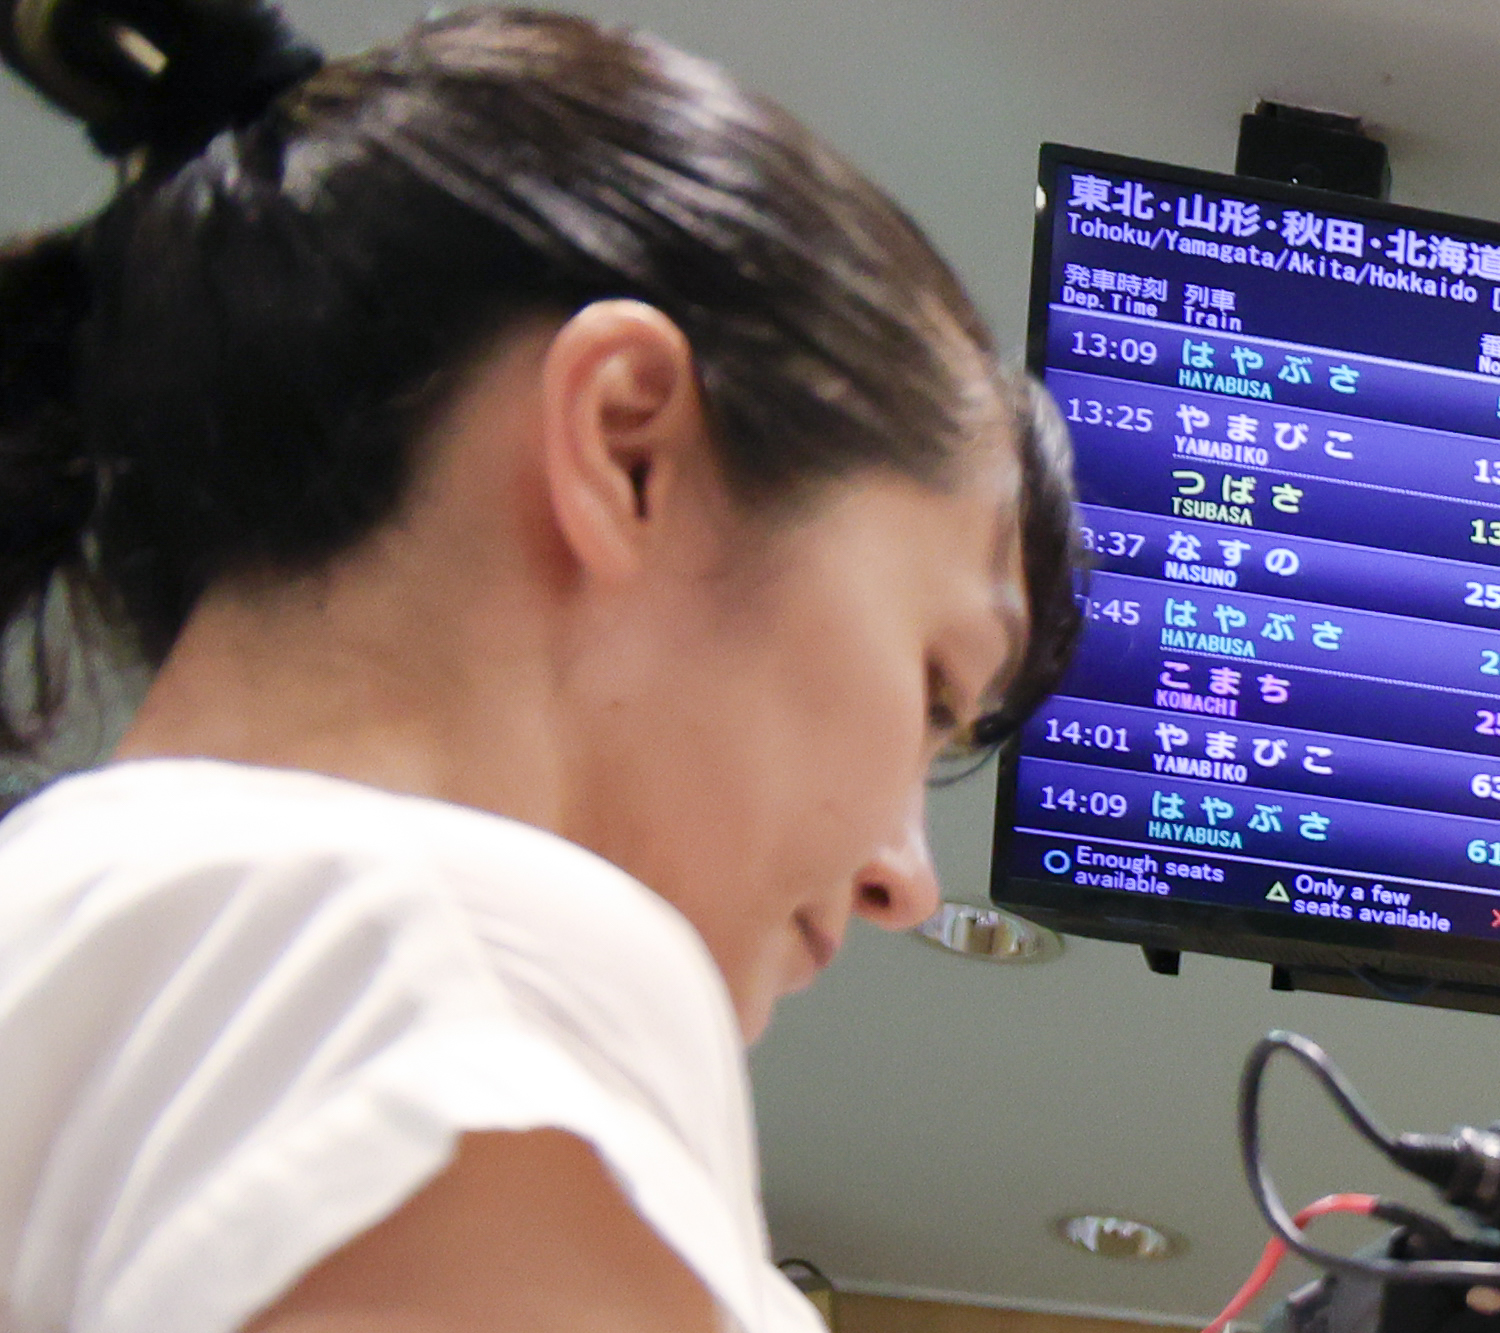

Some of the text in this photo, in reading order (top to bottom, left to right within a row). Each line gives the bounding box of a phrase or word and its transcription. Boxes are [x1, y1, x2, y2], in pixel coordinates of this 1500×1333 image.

[1067, 212, 1478, 303] Tohoku/Yamagata/Akita/Hokkaido
[1064, 263, 1237, 312] 発車時刻 列車
[1183, 305, 1242, 332] Train
[1070, 330, 1159, 366] 13:09
[1180, 336, 1361, 395] はやぶさ
[1178, 368, 1273, 400] HAYABUSA
[1067, 398, 1154, 433] 13:25
[1175, 401, 1354, 461] やまびこ
[1173, 436, 1269, 467] YAMABIKO
[1171, 468, 1304, 513] つばさ
[1171, 497, 1253, 526] TSUBASA
[1079, 527, 1146, 558] 3:37
[1167, 530, 1300, 577] なすの
[1163, 560, 1238, 588] NASUNO
[1160, 627, 1256, 658] HAYABUSA
[1163, 598, 1343, 651] はやぶさ
[1158, 660, 1292, 705] こまち
[1156, 688, 1239, 719] KOMACHI
[1045, 717, 1130, 753] 14:01
[1154, 722, 1334, 778] やまびこ
[1152, 753, 1248, 784] YAMABIKO
[1040, 785, 1128, 820] 14:09
[1151, 790, 1331, 844] はやぶさ
[1148, 820, 1244, 851] HAYABUSA
[1075, 865, 1170, 897] available
[1076, 845, 1225, 884] Enough seats
[1296, 875, 1411, 908] Only a few
[1294, 895, 1451, 934] seats available
